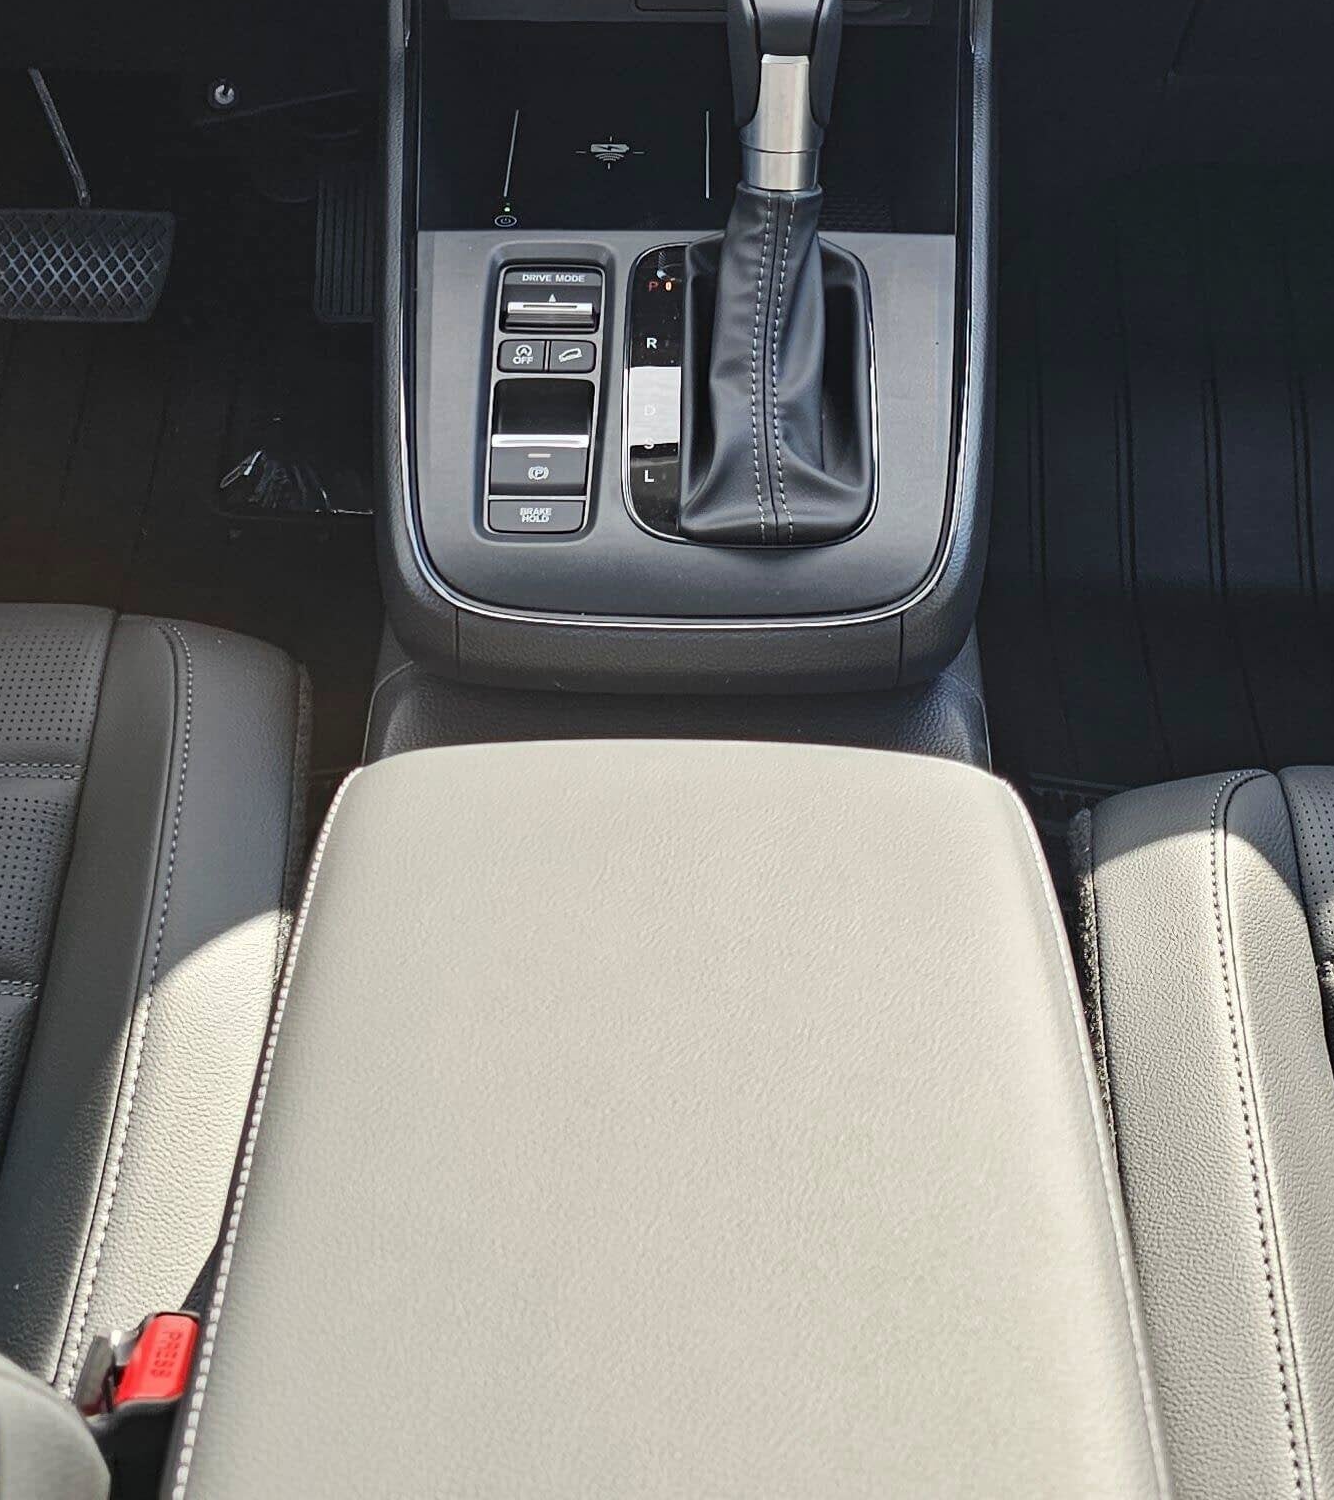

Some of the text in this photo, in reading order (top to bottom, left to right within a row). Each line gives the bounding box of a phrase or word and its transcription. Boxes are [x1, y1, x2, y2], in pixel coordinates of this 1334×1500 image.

[521, 273, 587, 283] DRIVE MODE
[648, 281, 659, 292] P
[646, 337, 658, 349] R
[512, 355, 534, 365] OFF
[644, 403, 656, 416] D
[644, 469, 655, 483] L
[519, 507, 552, 516] BRAKE
[521, 514, 550, 523] HOLD
